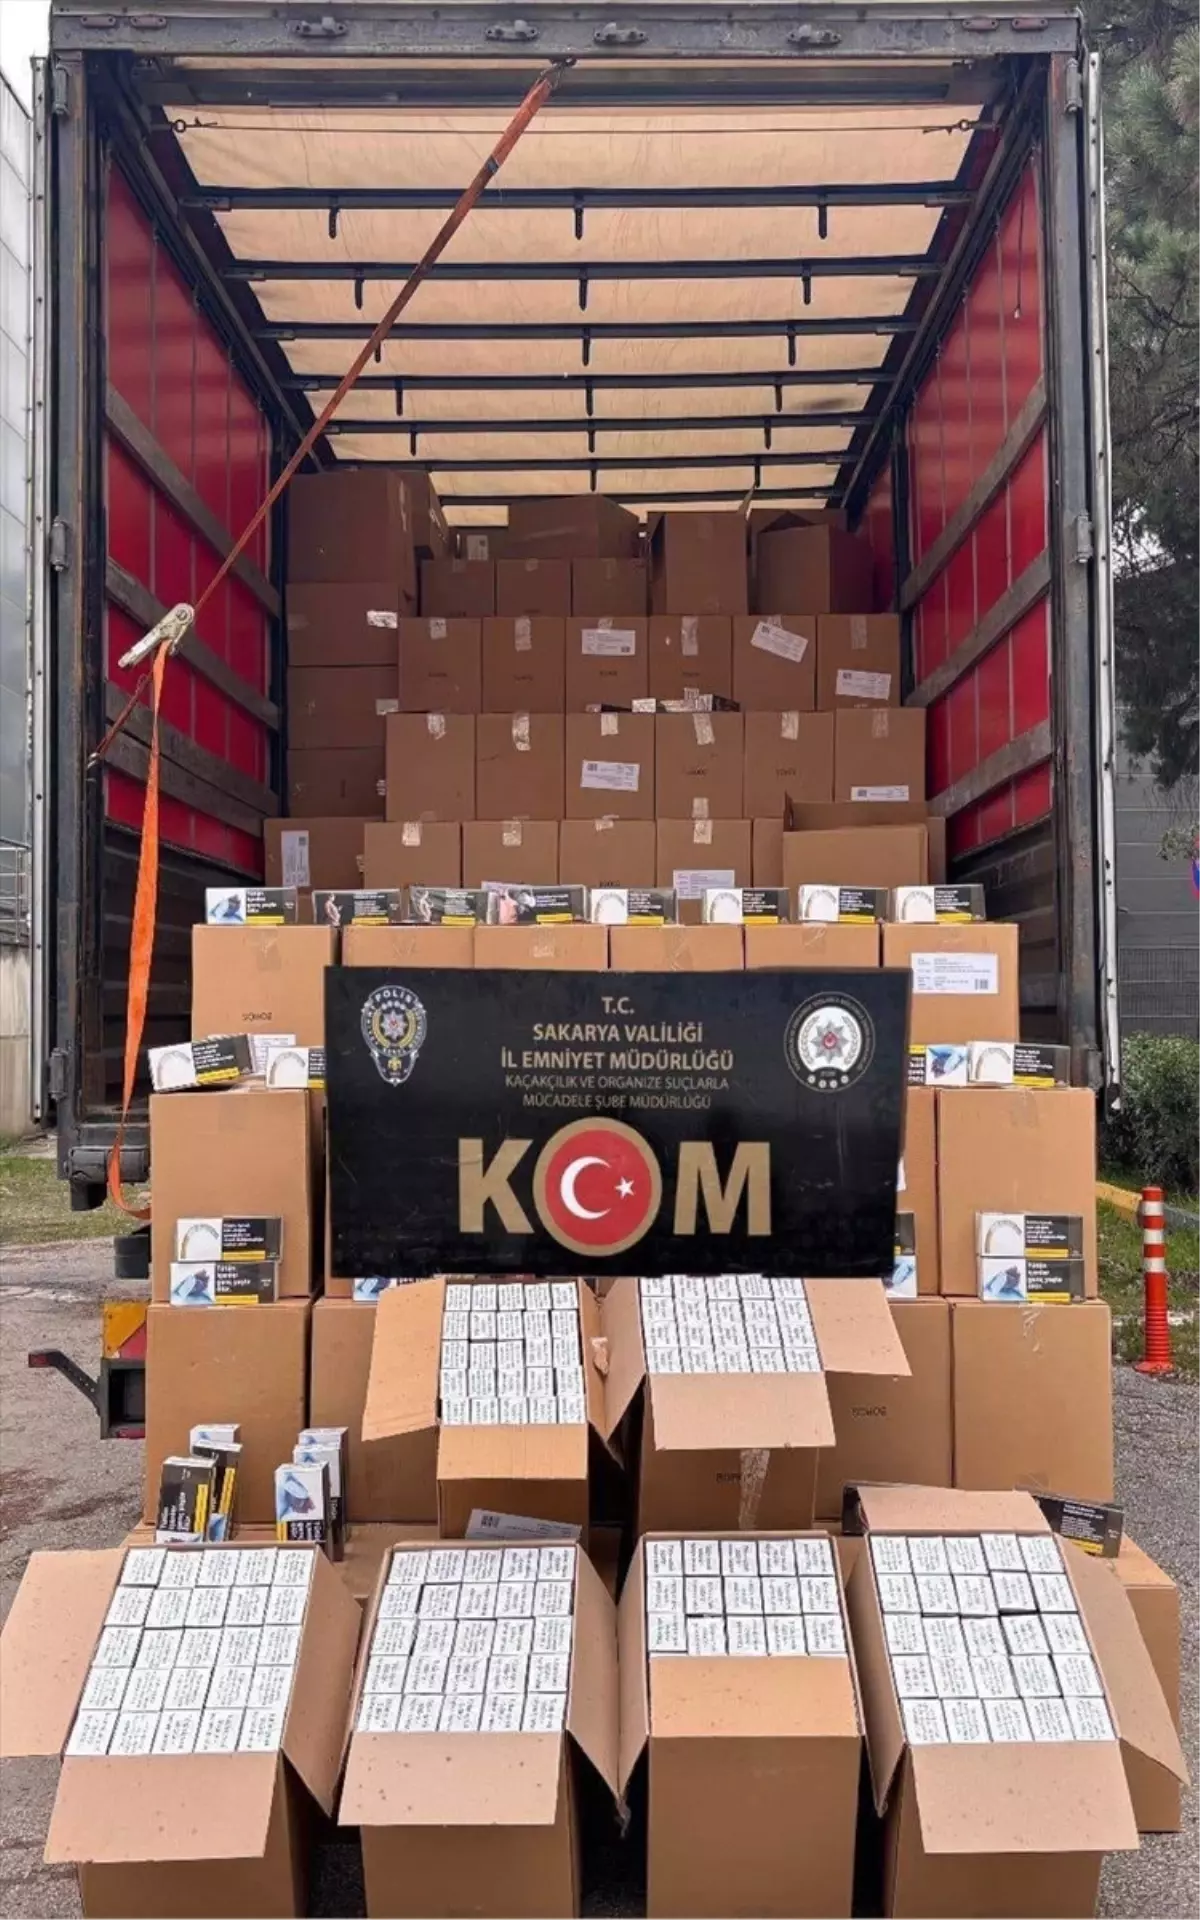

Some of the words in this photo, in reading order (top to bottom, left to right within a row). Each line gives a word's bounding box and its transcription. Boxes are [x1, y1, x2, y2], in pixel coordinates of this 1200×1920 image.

[601, 996, 635, 1014] T.C.
[532, 1023, 620, 1042] SAKARYA
[625, 1021, 703, 1043] VALİLİĞİ
[501, 1047, 518, 1069] İL
[522, 1047, 604, 1069] EMNİYET
[609, 1050, 733, 1071] MÜDÜRLÜĞÜ
[505, 1074, 578, 1091] KAÇAKÇILIK
[579, 1075, 595, 1088] VE
[664, 1076, 729, 1092] SUÇLARLA
[523, 1093, 593, 1108] MÜCADELE
[595, 1095, 627, 1111] ŞUBE
